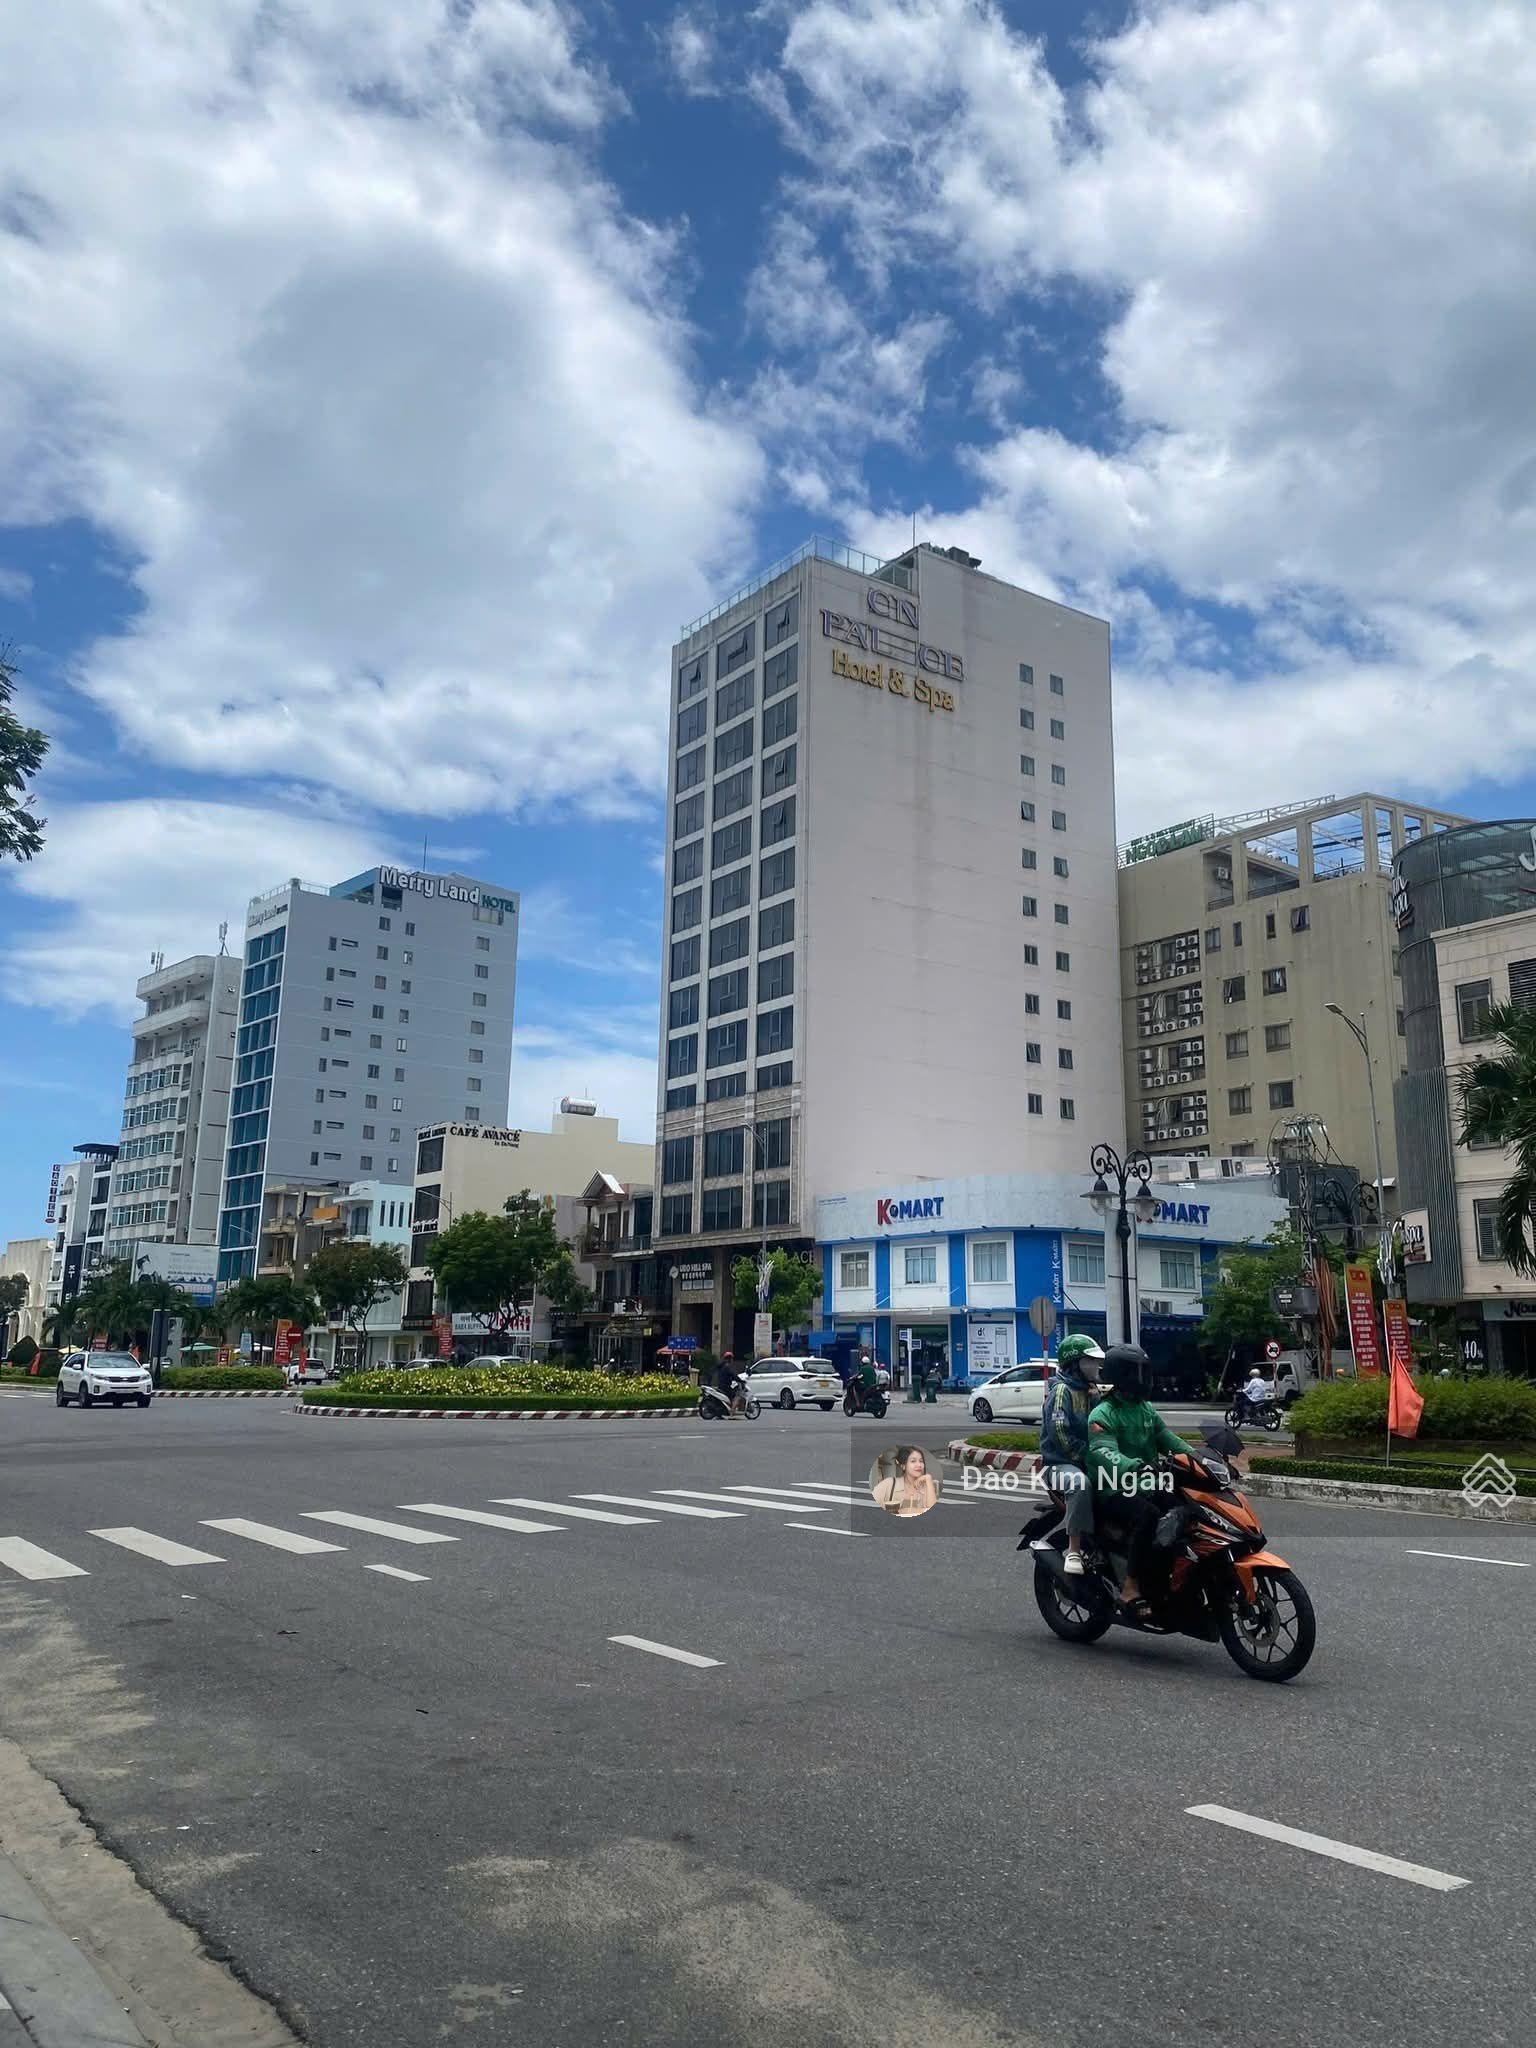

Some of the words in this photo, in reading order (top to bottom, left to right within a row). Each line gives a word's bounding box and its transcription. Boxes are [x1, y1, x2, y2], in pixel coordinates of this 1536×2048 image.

[832, 649, 884, 689] Hotel
[888, 668, 909, 697] &
[914, 676, 955, 712] Spa
[380, 865, 435, 898] Merry
[438, 879, 480, 904] Land
[480, 895, 515, 913] HOTEL
[450, 1126, 479, 1138] CAFÉ
